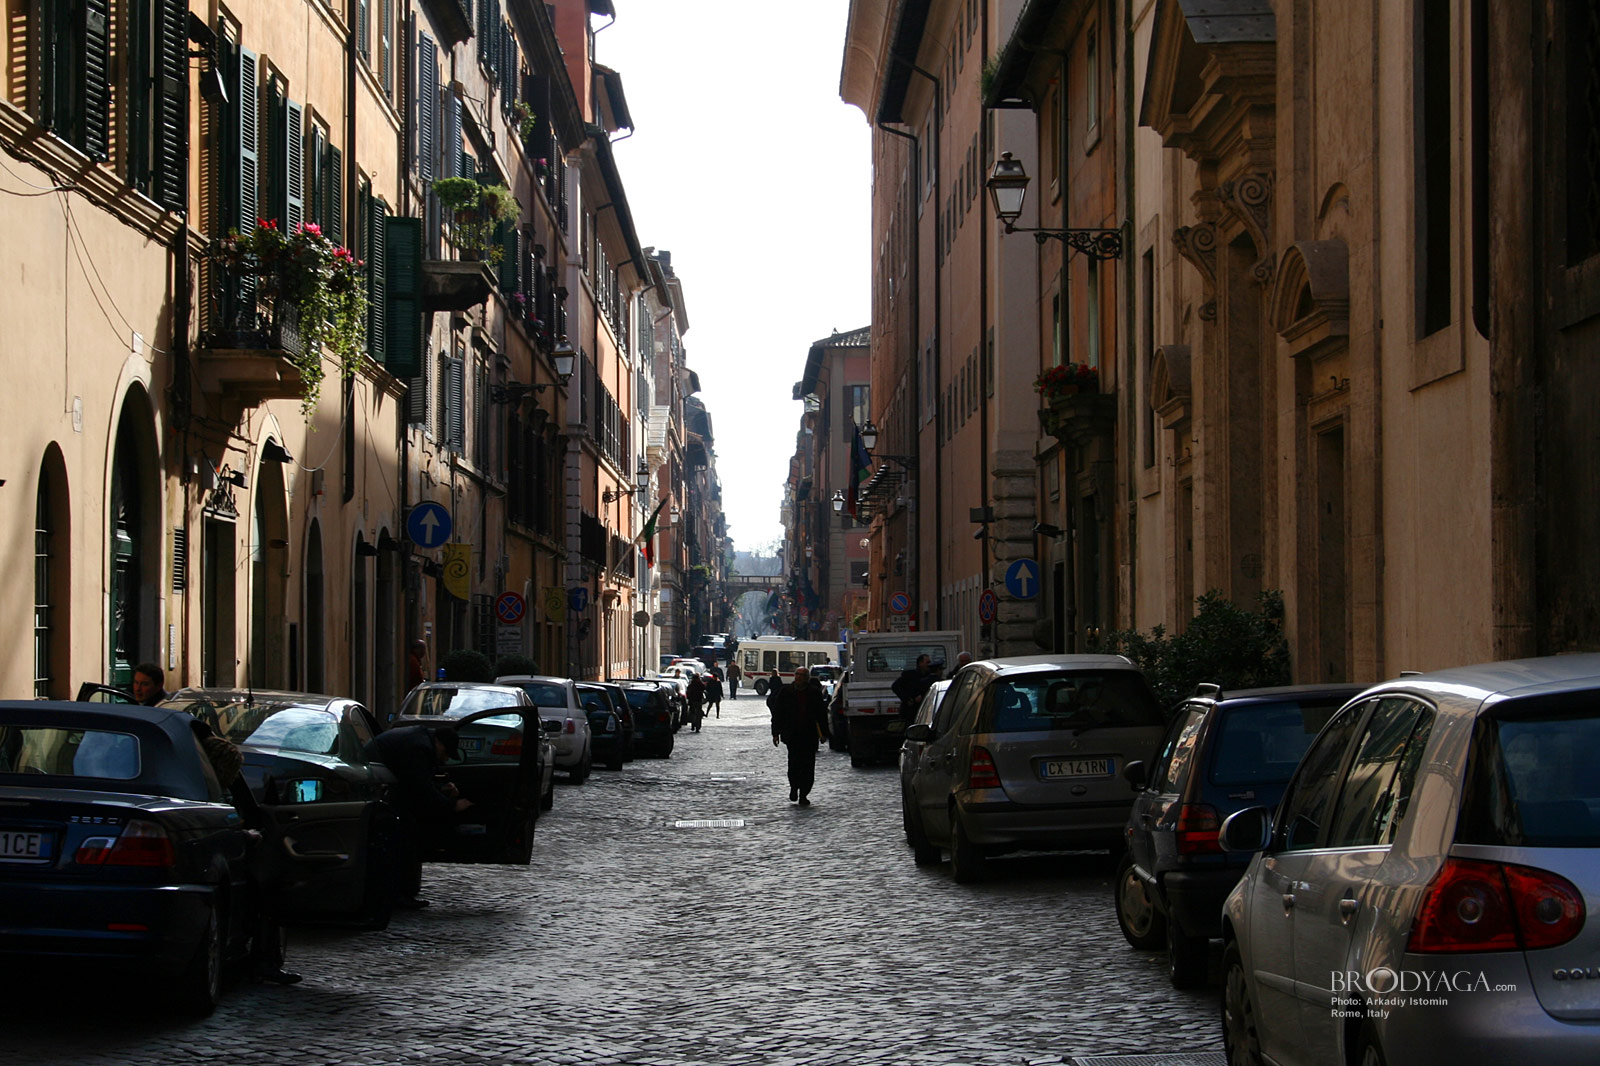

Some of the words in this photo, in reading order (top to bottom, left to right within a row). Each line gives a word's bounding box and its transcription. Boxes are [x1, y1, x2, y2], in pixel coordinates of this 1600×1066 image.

[1048, 762, 1064, 775] CX
[1069, 761, 1106, 774] 141RN
[1552, 967, 1600, 980] GOL
